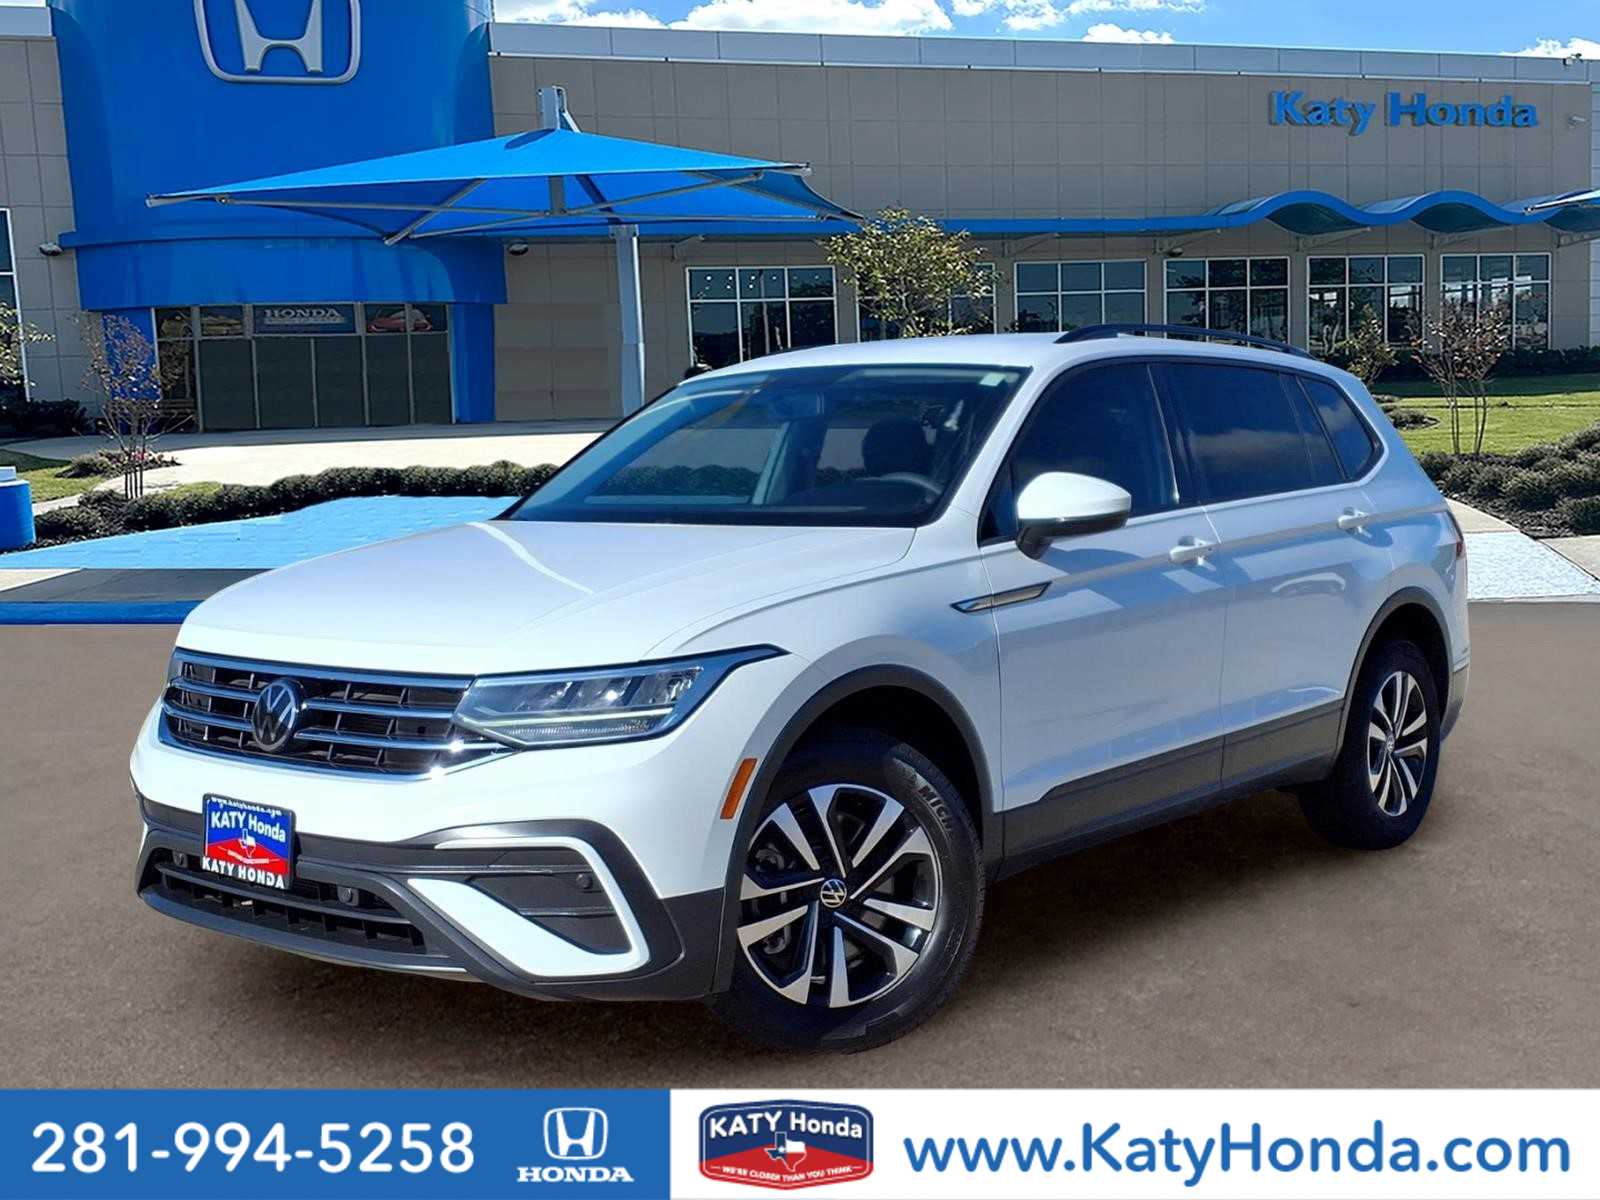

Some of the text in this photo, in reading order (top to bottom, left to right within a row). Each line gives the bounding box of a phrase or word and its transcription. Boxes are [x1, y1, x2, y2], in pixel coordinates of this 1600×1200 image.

[1269, 90, 1539, 136] Katy Honda
[264, 308, 342, 319] HONDA
[211, 810, 287, 843] KATY Honda
[202, 856, 237, 876] KATY
[238, 865, 285, 890] HONDA
